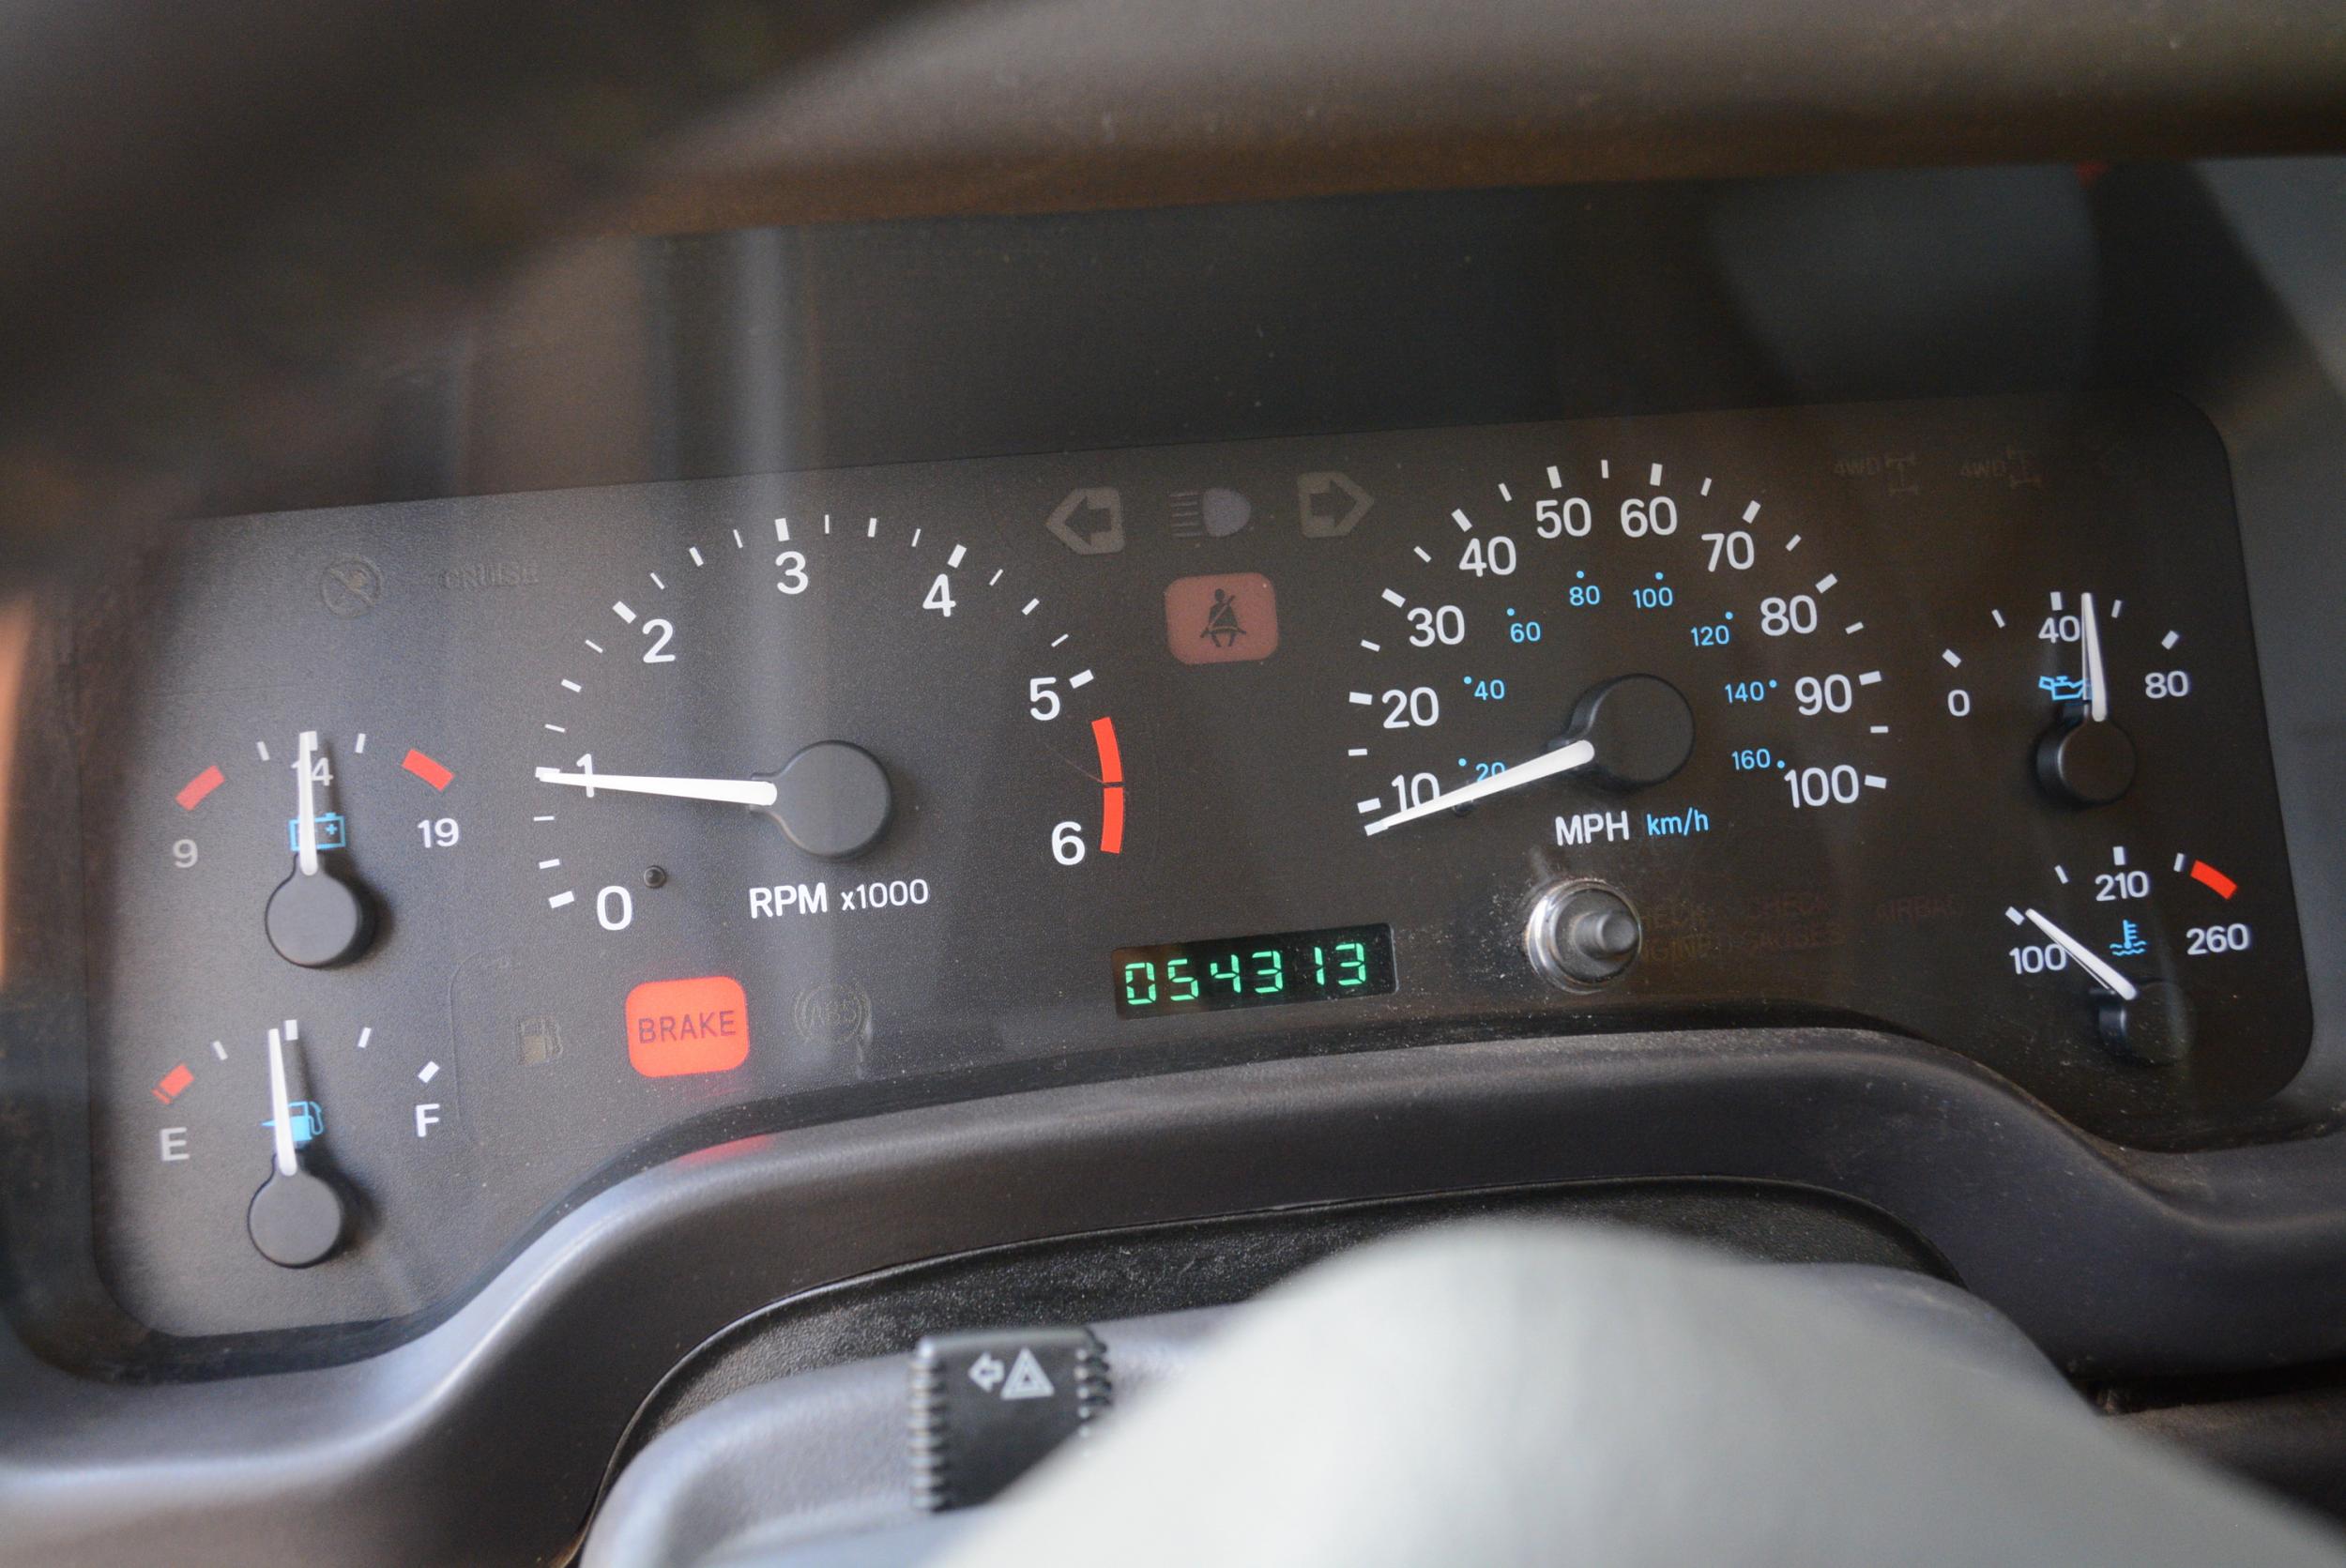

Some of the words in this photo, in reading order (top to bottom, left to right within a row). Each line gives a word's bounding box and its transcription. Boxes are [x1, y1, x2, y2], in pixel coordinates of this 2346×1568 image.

[1536, 498, 1591, 539] 50
[1621, 496, 1677, 537] 60
[1459, 537, 1516, 577] 40
[1701, 531, 1754, 571] 70
[776, 552, 808, 594] 3
[922, 574, 956, 617] 4
[1570, 586, 1600, 605] 80
[1634, 587, 1672, 608] 100
[1408, 605, 1465, 647] 30
[1511, 622, 1540, 642] 60
[1760, 595, 1817, 635] 80
[2038, 616, 2080, 643] 40
[643, 619, 676, 662] 2
[1691, 625, 1729, 646] 120
[1030, 677, 1060, 721] 5
[1475, 680, 1504, 700] 40
[1726, 682, 1764, 703] 140
[1795, 675, 1851, 715] 90
[1948, 690, 1970, 716] 0
[2145, 671, 2188, 698] 80
[1382, 687, 1439, 728] 20
[576, 754, 594, 797] 1
[1732, 749, 1770, 769] 160
[1391, 772, 1440, 812] 10
[1785, 765, 1859, 808] 100
[418, 818, 459, 847] 19
[1052, 822, 1085, 865] 6
[1556, 813, 1629, 845] MPH
[1647, 808, 1708, 835] km/h
[174, 839, 198, 867] 9
[750, 883, 827, 919] RPM
[841, 879, 928, 910] x1000
[2095, 871, 2149, 901] 210
[597, 886, 632, 930] 0
[2186, 923, 2249, 954] 260
[1125, 943, 1365, 1005] 054313
[2009, 943, 2067, 974] 100
[638, 1010, 736, 1044] BRAKE
[416, 1104, 439, 1137] F
[160, 1127, 190, 1161] E
